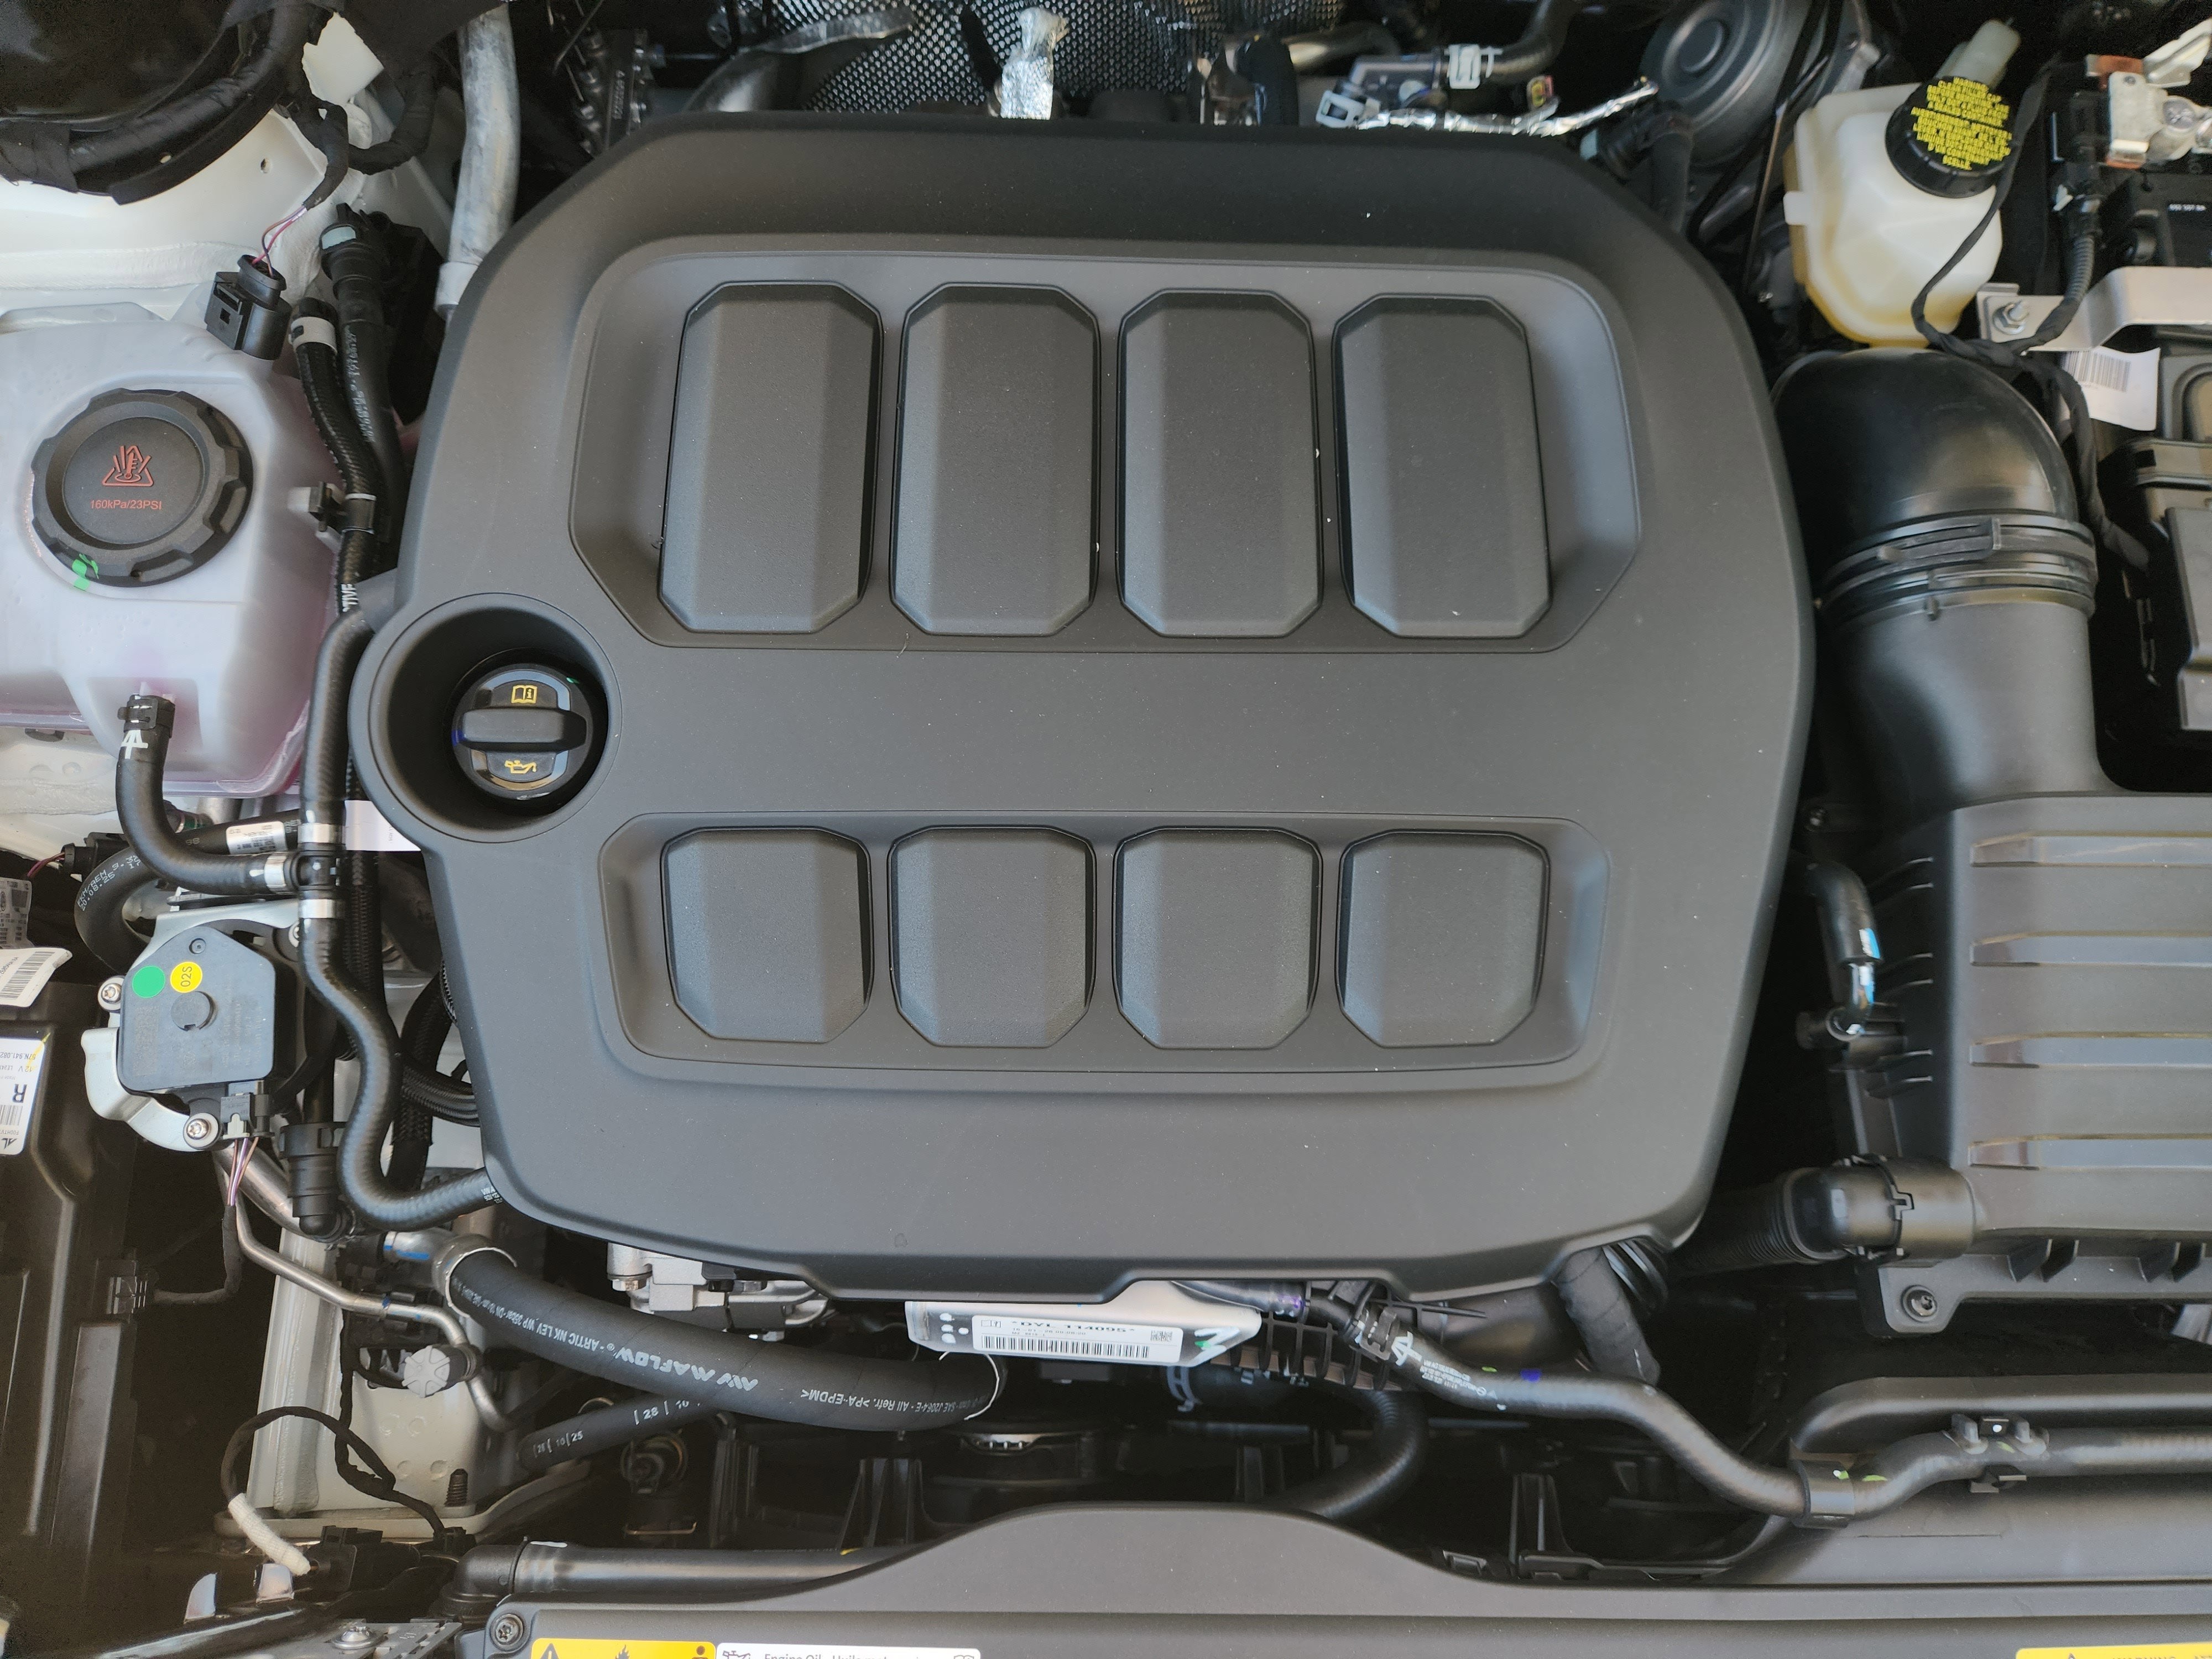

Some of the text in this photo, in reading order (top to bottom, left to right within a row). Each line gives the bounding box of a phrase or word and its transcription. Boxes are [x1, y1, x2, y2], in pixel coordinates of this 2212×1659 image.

[90, 499, 162, 510] 160kPa/23PSI
[12, 1083, 28, 1103] R
[553, 1327, 567, 1342] NK
[567, 1332, 600, 1352] ARTIC
[873, 1398, 895, 1411] Refr.
[897, 1401, 909, 1412] All
